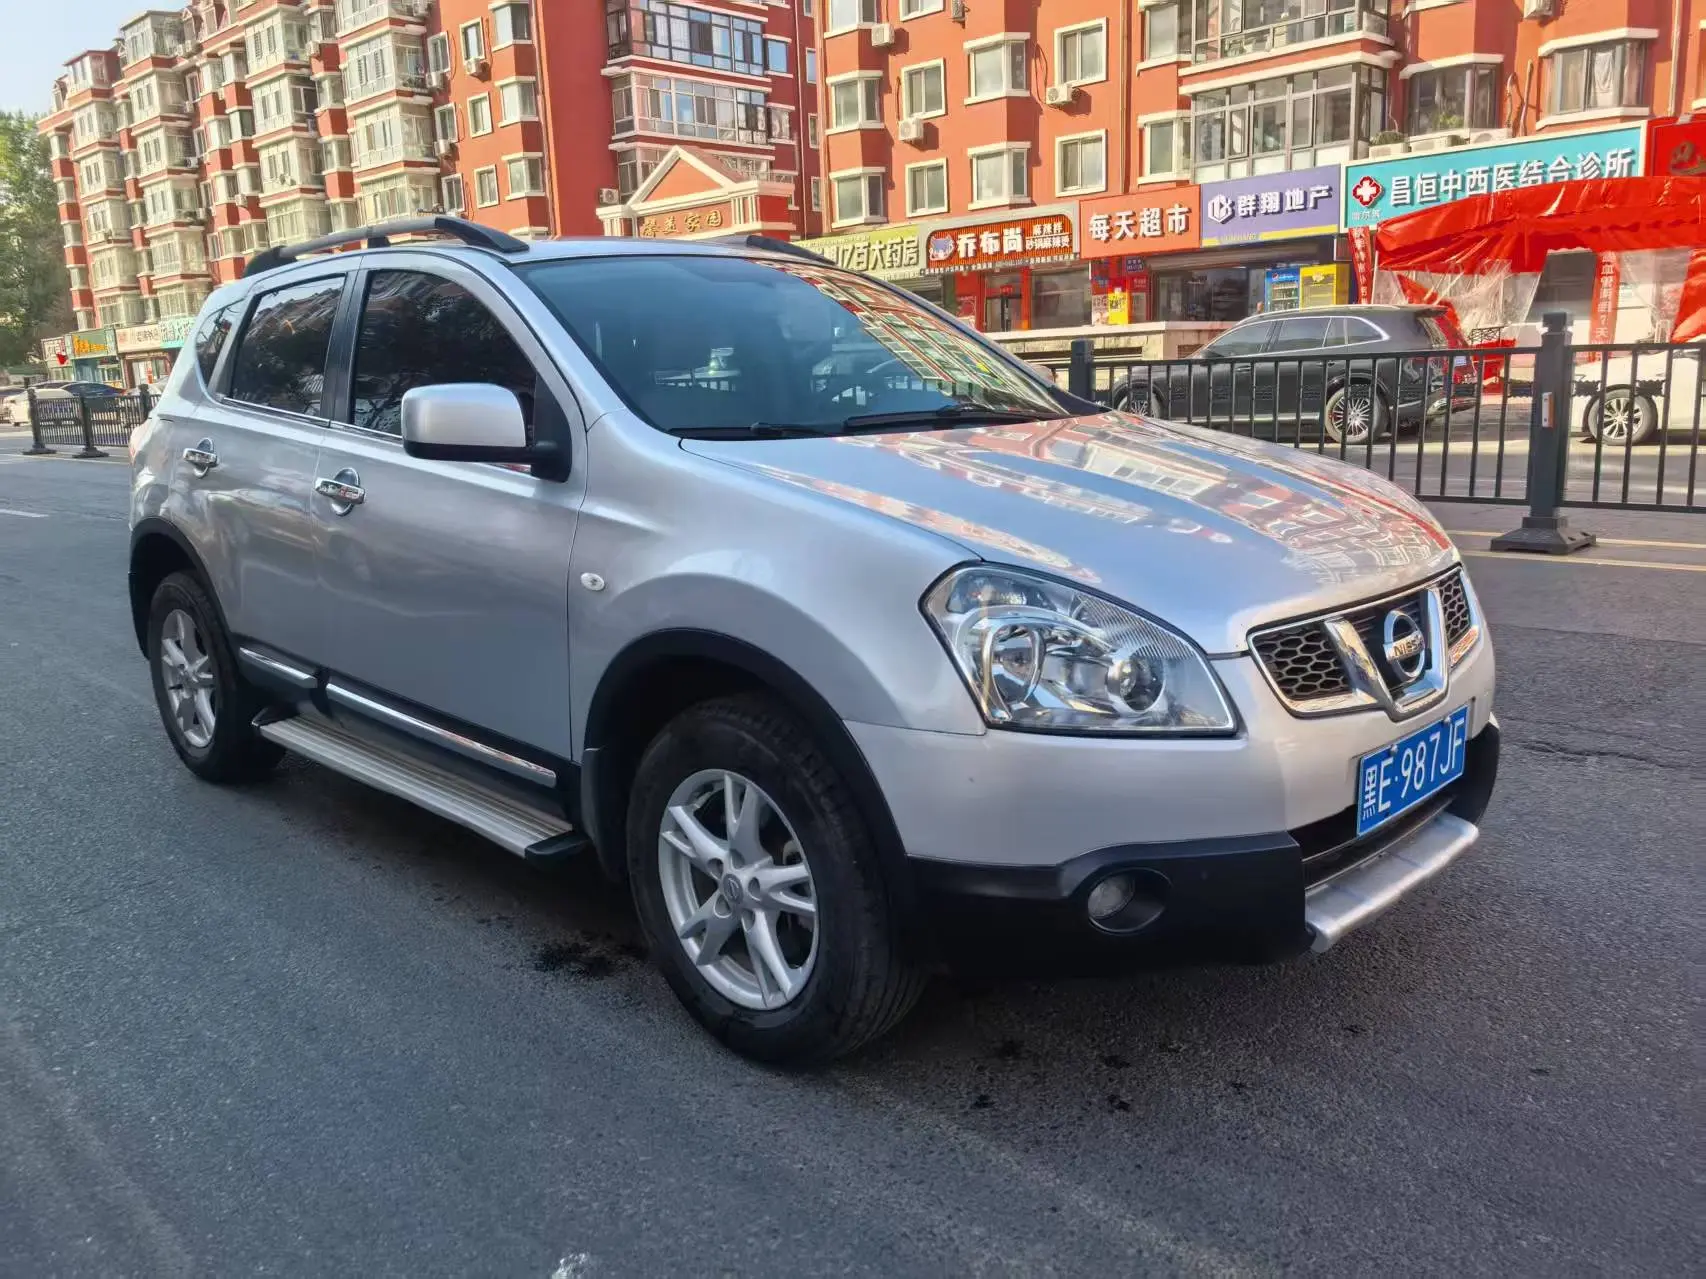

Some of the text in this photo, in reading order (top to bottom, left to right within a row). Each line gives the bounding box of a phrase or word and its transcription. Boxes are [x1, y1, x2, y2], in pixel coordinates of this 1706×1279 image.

[1389, 148, 1634, 206] 昌恒中西医结合诊所
[1237, 185, 1332, 217] 群翔地产
[1089, 203, 1191, 241] 每天超市
[956, 227, 1024, 258] 乔布尚
